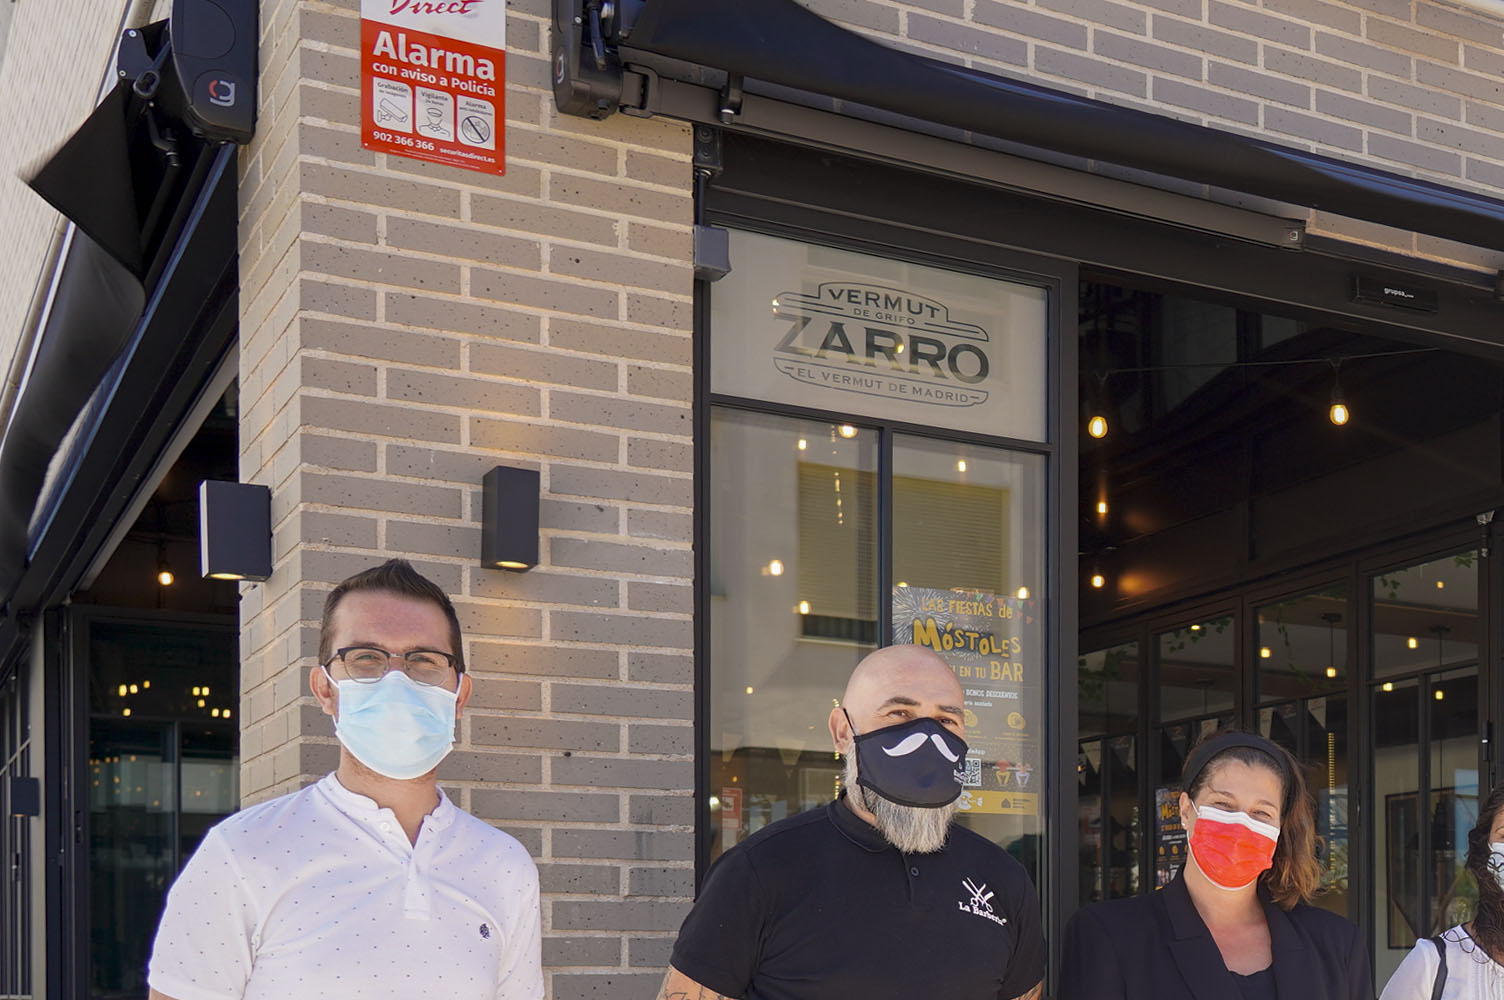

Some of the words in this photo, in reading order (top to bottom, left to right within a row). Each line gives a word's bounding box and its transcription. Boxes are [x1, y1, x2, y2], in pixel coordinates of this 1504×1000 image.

[372, 30, 496, 82] Alarma
[372, 62, 397, 76] con
[400, 68, 437, 85] aviso
[439, 77, 449, 87] a
[451, 77, 496, 97] Policía
[421, 90, 449, 101] Vigilante
[465, 100, 487, 110] Alarma
[373, 131, 393, 143] 902
[394, 135, 414, 147] 366
[415, 139, 435, 151] 366
[827, 288, 940, 319] VERMUT
[853, 308, 870, 318] DE
[875, 312, 916, 325] GRIFO
[773, 312, 990, 385] ZARRO
[797, 367, 816, 380] EL
[821, 370, 883, 390] VERMUT
[888, 382, 908, 394] DE
[912, 386, 969, 403] MADRID
[922, 599, 944, 612] LAS
[948, 600, 993, 617] FIESTAS
[999, 603, 1014, 619] de
[960, 665, 971, 677] EN
[975, 666, 986, 679] TU
[990, 661, 1024, 682] BAR
